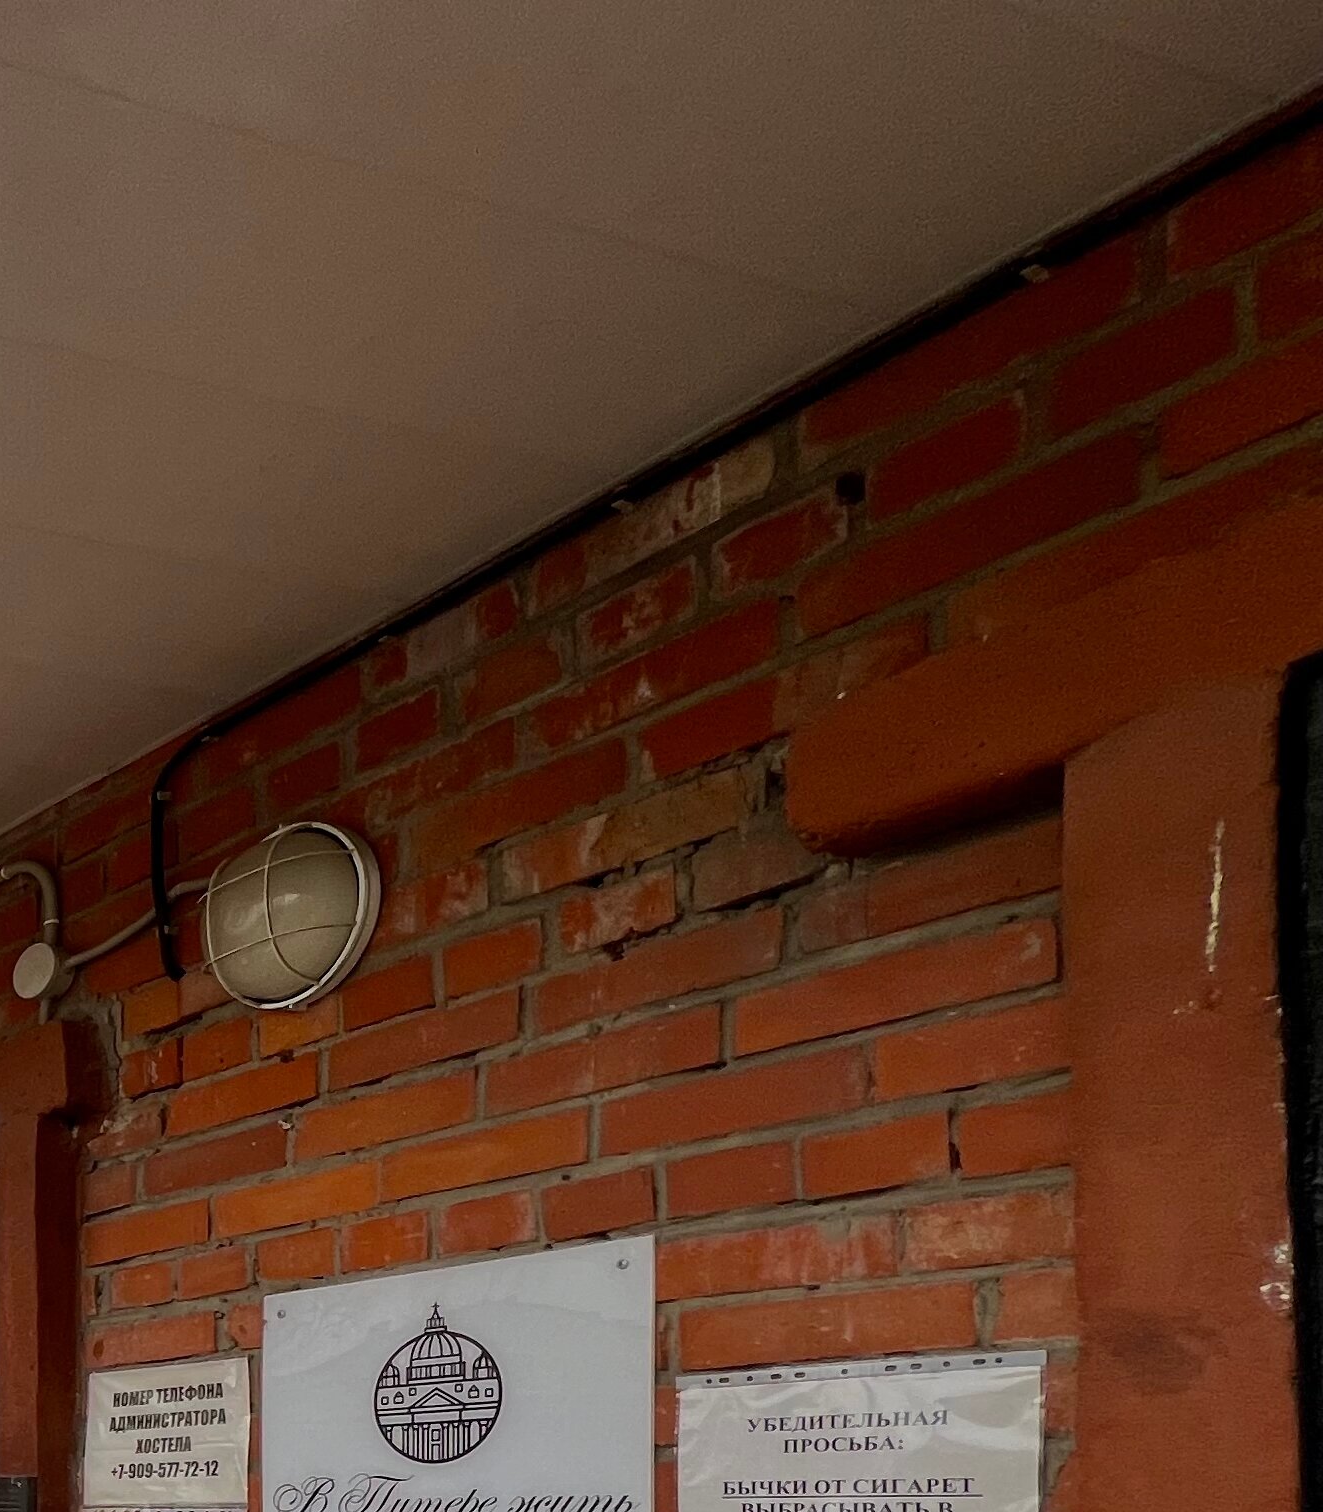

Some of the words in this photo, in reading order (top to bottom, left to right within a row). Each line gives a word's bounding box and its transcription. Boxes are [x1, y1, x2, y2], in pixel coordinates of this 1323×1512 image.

[113, 1389, 154, 1407] НОМЕР
[155, 1382, 224, 1404] ТЕЛЕФОНА
[108, 1408, 227, 1434] АДМИНИСТРАТОРА
[746, 1409, 949, 1433] УБЕДИТЕЛЬНАЯ
[135, 1436, 192, 1454] ХОСТЕЛА
[783, 1436, 906, 1455] ПРОСЬБА:
[111, 1460, 219, 1480] +7-909-577-72-12
[722, 1479, 808, 1496] БЫЧКИ
[814, 1479, 847, 1495] ОТ
[853, 1477, 975, 1495] СИГАРЕТ
